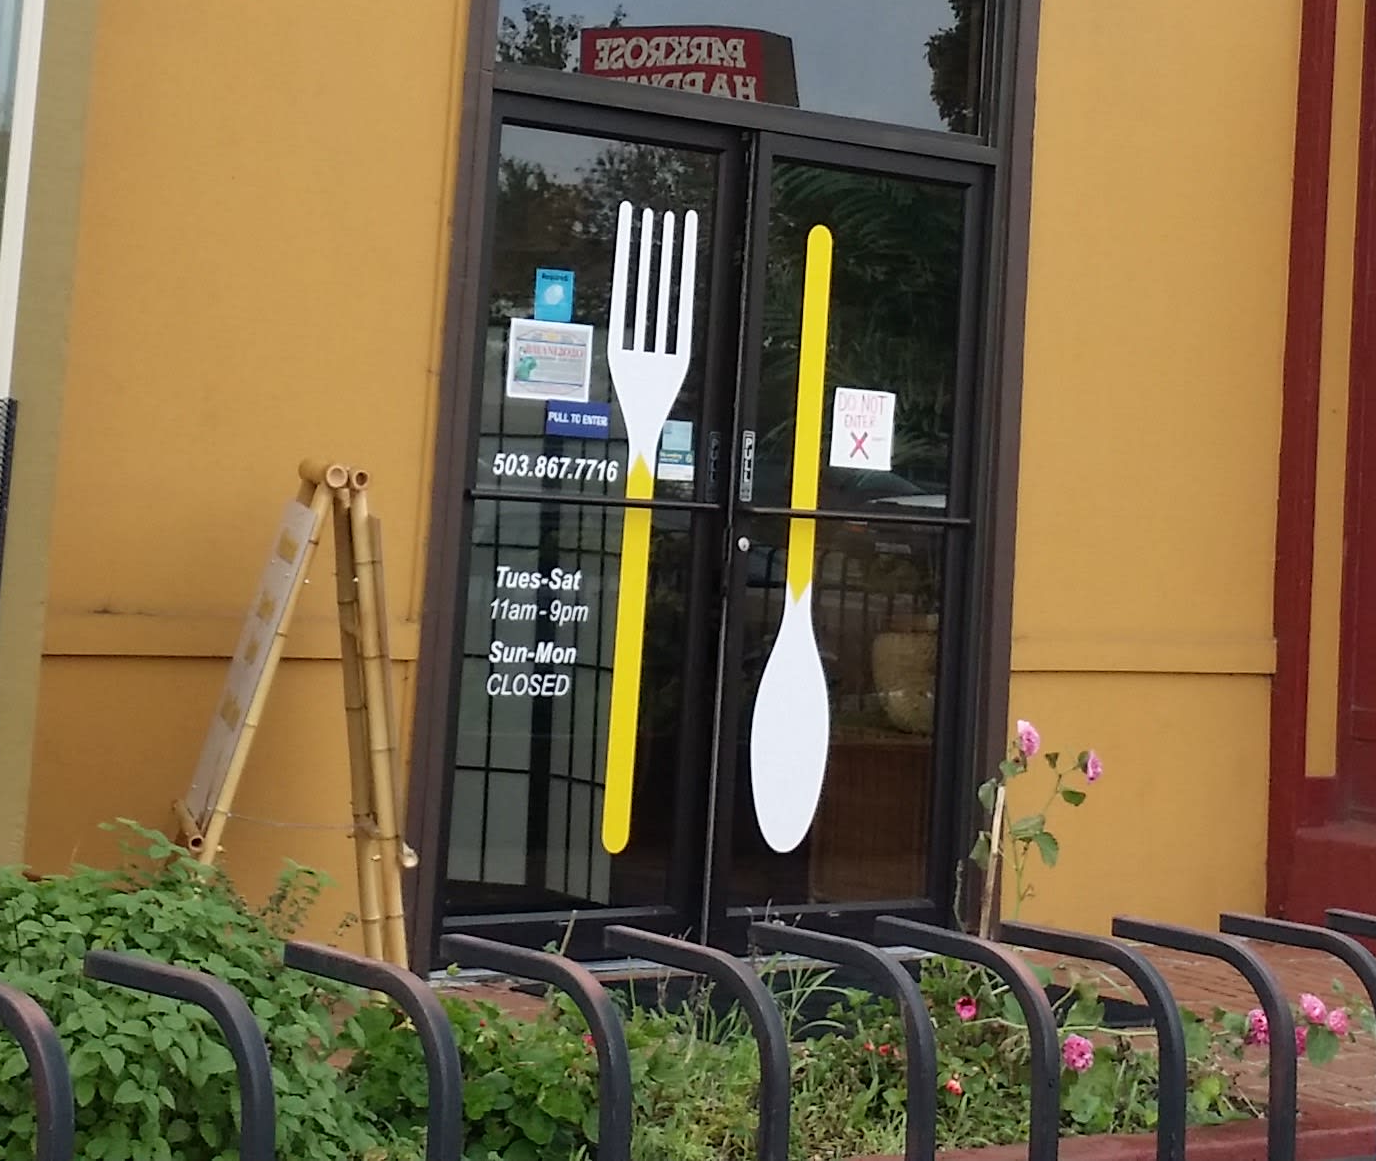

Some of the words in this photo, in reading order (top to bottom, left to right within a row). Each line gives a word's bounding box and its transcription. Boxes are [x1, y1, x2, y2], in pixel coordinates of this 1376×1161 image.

[838, 391, 857, 412] DO
[862, 393, 888, 416] NOT
[547, 411, 569, 423] PULL
[570, 413, 582, 424] TO
[582, 414, 609, 427] ENTER
[493, 453, 619, 483] 503.867.7716
[743, 437, 754, 483] PULL
[496, 565, 582, 591] Tues-Sat
[488, 641, 577, 664] Sun-Mon
[486, 673, 570, 696] CLOSED
